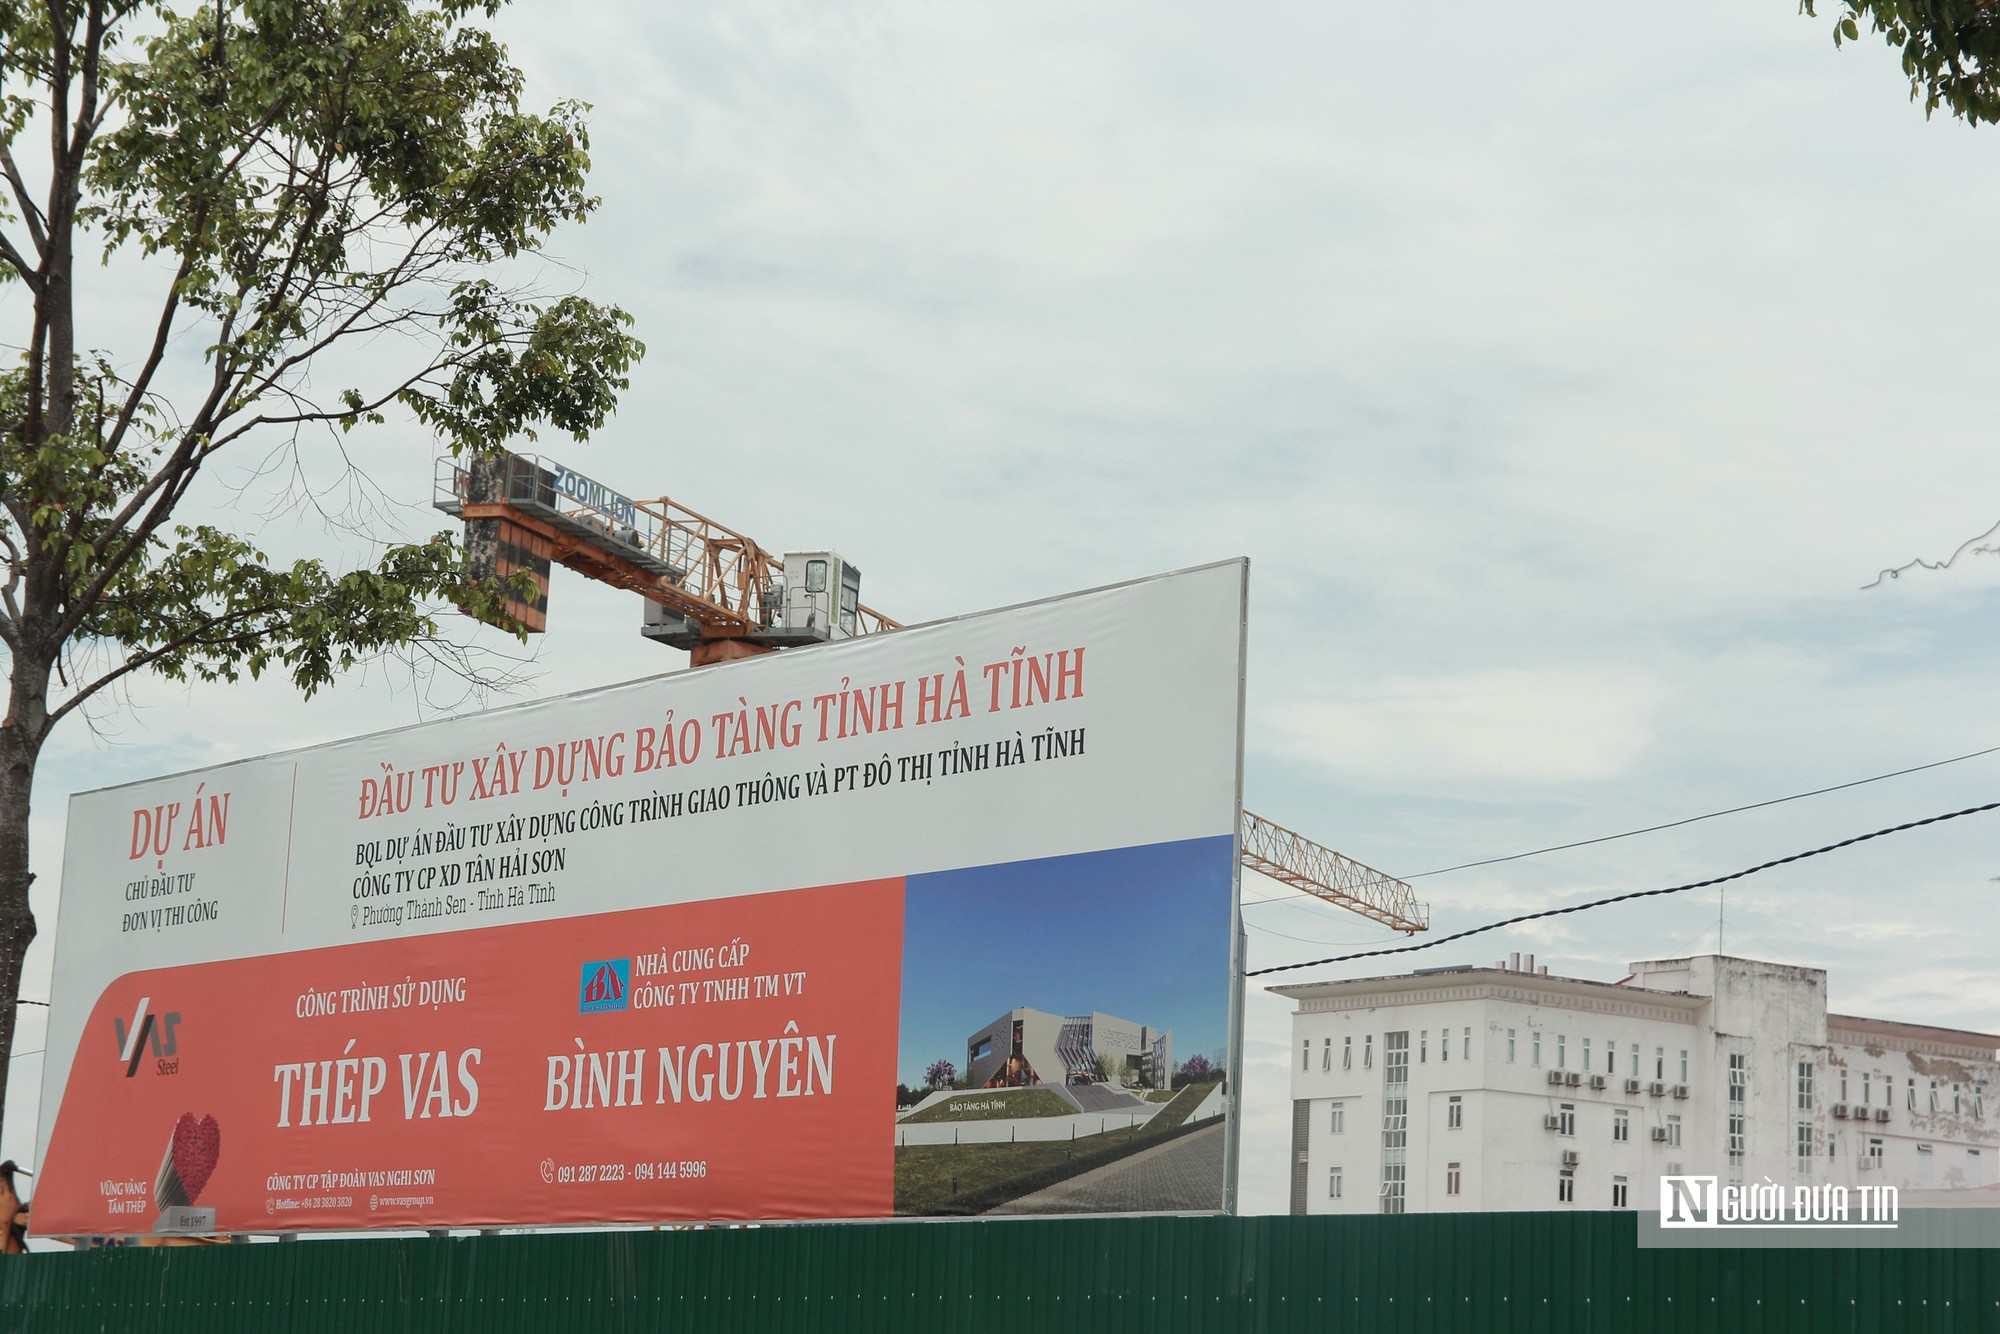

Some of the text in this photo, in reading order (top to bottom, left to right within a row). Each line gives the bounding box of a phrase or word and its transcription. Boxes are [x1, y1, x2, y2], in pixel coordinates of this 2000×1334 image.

[553, 464, 635, 527] ZOOMLION
[358, 645, 1086, 819] ĐẦU TƯ XÂY DỰNG BẢO TÀNG TỈNH HÀ TĨNH
[355, 726, 1086, 869] BQL DỰ ÁN ĐẦU TƯ XÂY DỰNG CÔNG TRÌNH GIAO THÔNG VÀ PT ĐÔ THỊ TỈNH HÀ TĨNH
[129, 782, 231, 869] DỰ ÁN
[125, 871, 195, 901] CHỦ ĐẦU TƯ
[353, 847, 566, 899] CÔNG TY CP XD TÂN HẢI SƠN
[122, 898, 218, 932] ĐƠN VỊ THI CÔNG
[362, 903, 404, 926] Phường
[406, 897, 442, 920] Thành
[445, 895, 467, 916] Sen
[478, 888, 504, 911] Tỉnh
[507, 885, 525, 907] Hà
[528, 882, 556, 905] Tĩnh
[635, 937, 750, 977] NHÀ CUNG CẤP
[296, 975, 467, 1018] CÔNG TRÌNH SỬ DỤNG
[633, 971, 806, 1010] CÔNG TY TNHH TM VT
[114, 997, 182, 1078] VAS
[156, 1059, 179, 1076] Steel
[274, 1038, 482, 1128] THÉP VAS
[544, 1020, 837, 1111] BÌNH NGUYÊN
[267, 1168, 435, 1192] CÔNG TY CP TẬP ĐOÀN VAS NGHI SƠN
[558, 1165, 576, 1183] 091
[578, 1164, 597, 1182] 287
[599, 1164, 625, 1181] 2223
[634, 1162, 654, 1180] 094
[657, 1161, 677, 1179] 144
[679, 1160, 707, 1178] 5996
[126, 1197, 147, 1213] THÉP
